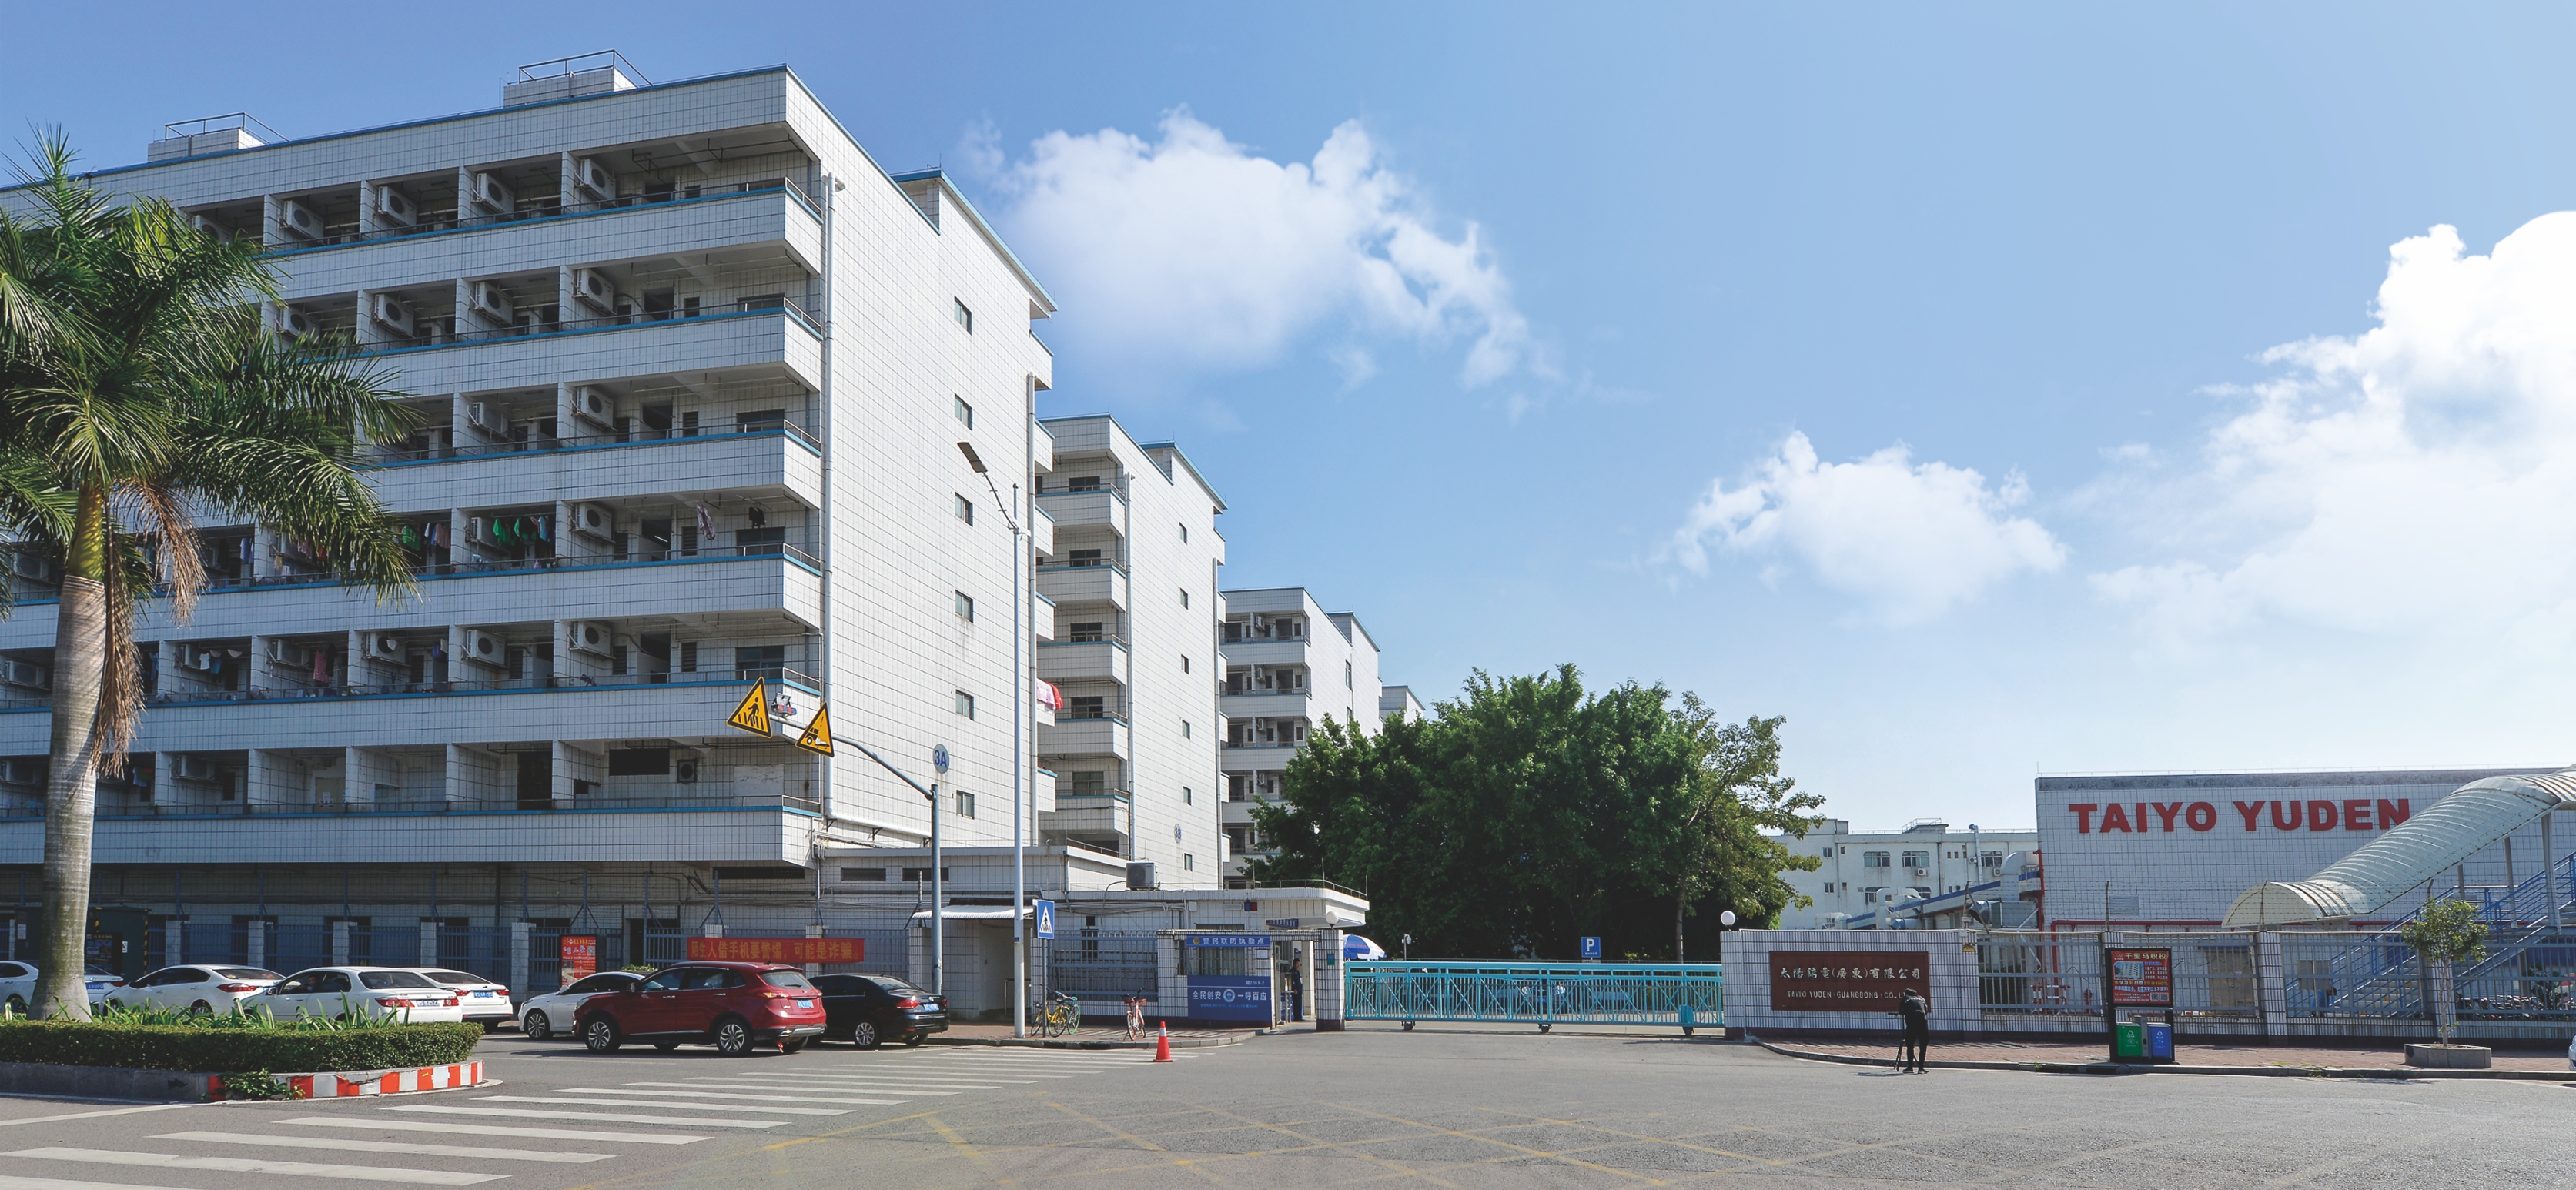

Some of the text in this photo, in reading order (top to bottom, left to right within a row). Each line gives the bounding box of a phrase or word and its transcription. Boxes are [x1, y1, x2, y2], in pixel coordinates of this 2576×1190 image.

[935, 750, 947, 768] 3A
[2069, 798, 2410, 834] TAIYO YUDEN
[1587, 938, 1595, 951] P
[1193, 991, 1267, 1001] 全民创安 一呼百应
